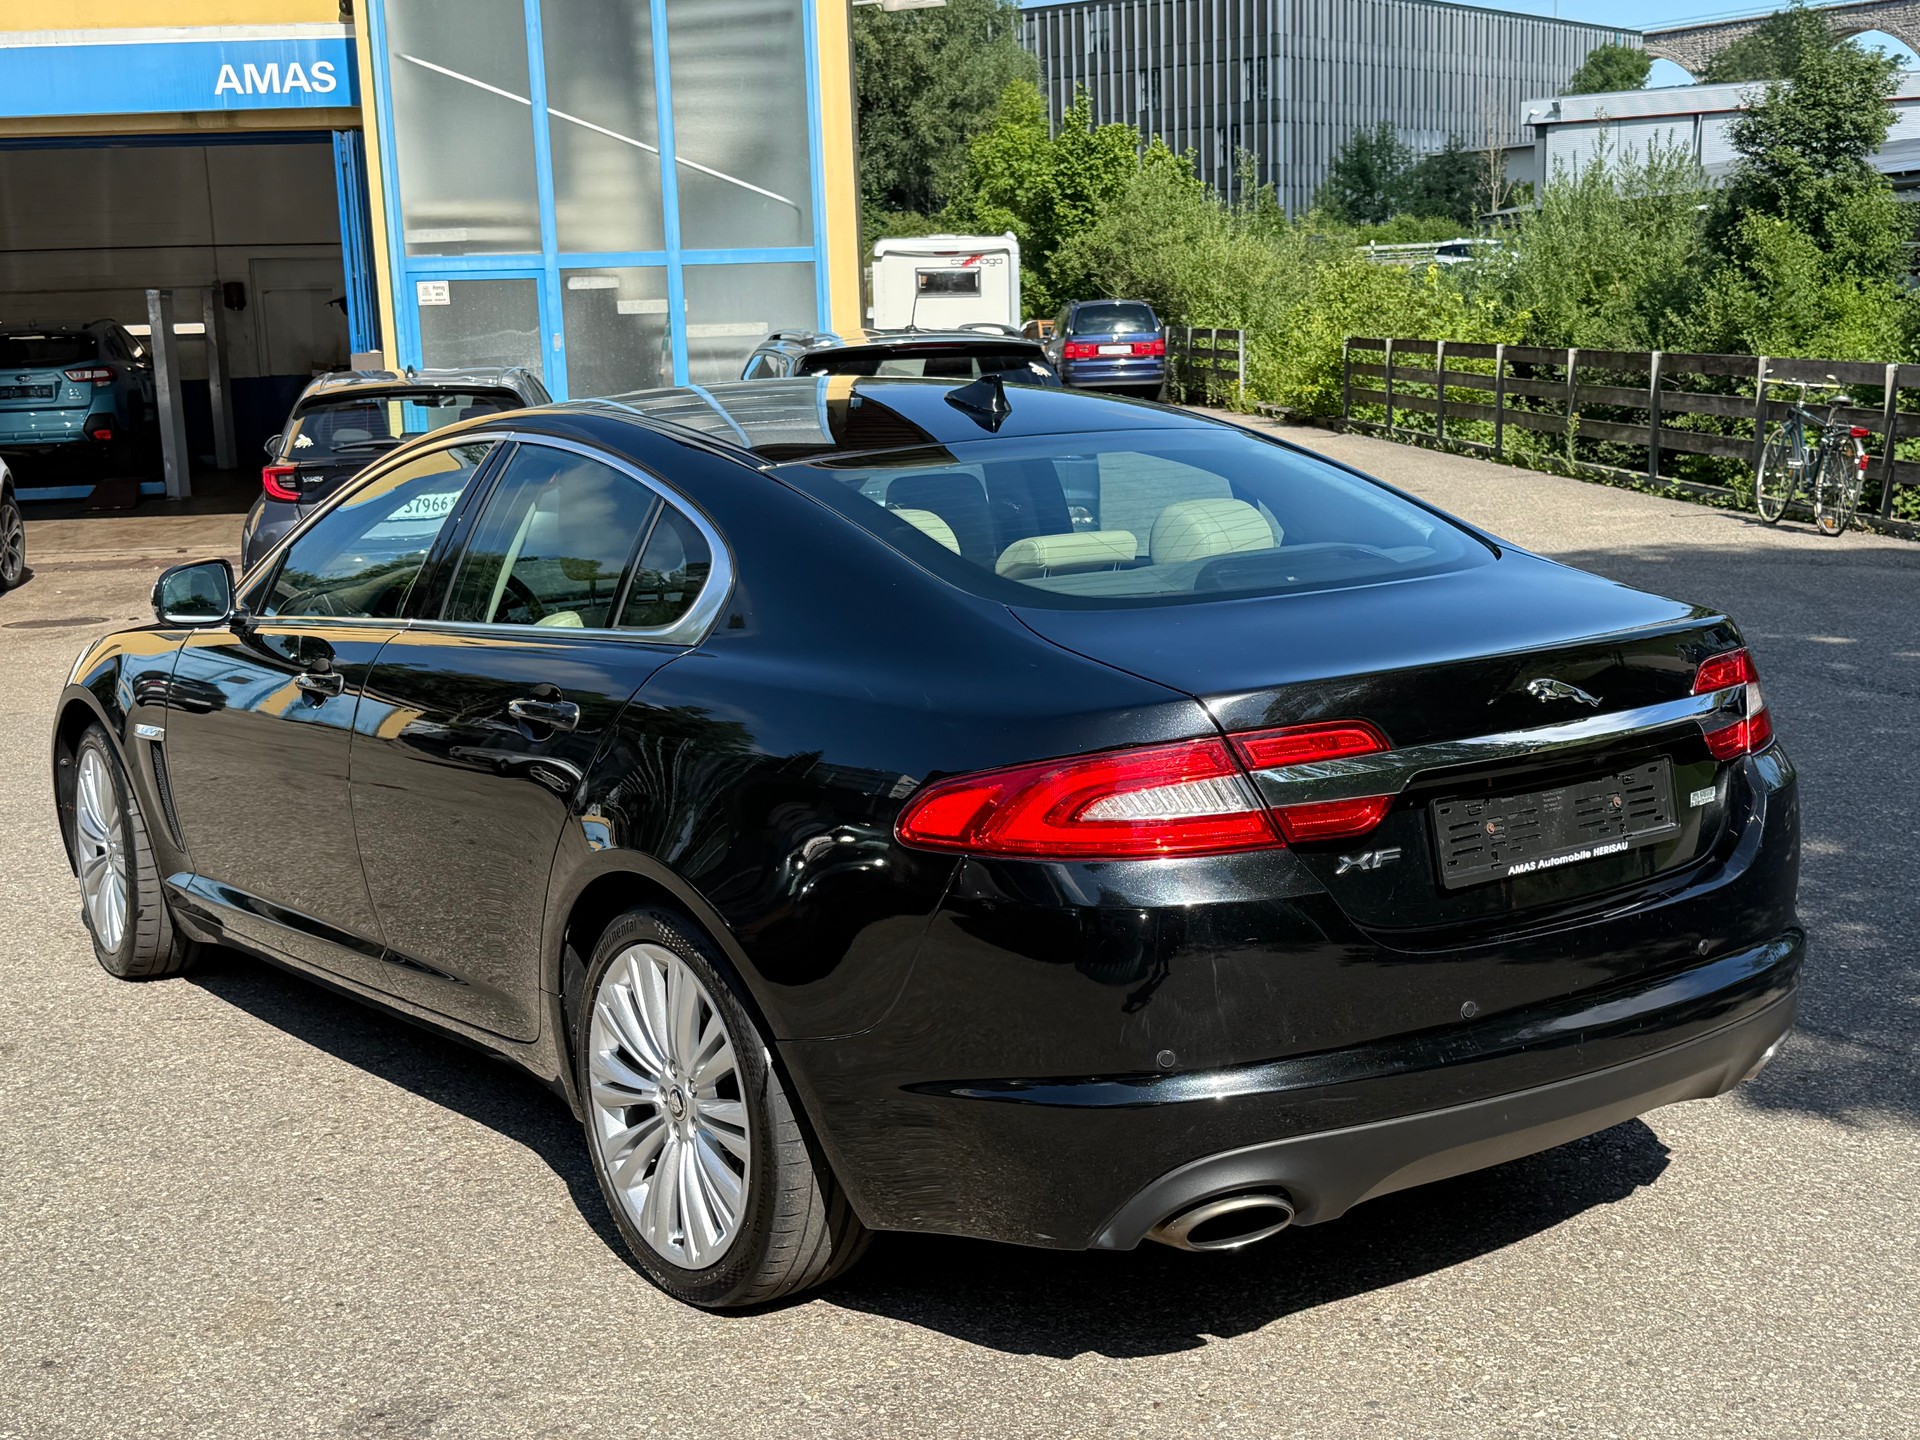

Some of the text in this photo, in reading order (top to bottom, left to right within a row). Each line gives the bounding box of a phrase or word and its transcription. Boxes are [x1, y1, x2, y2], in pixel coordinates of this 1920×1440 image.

[214, 60, 337, 95] AMAS
[1335, 847, 1401, 875] XF
[1507, 841, 1629, 875] AMAS Automobile HERISAU
[595, 919, 637, 965] Continental
